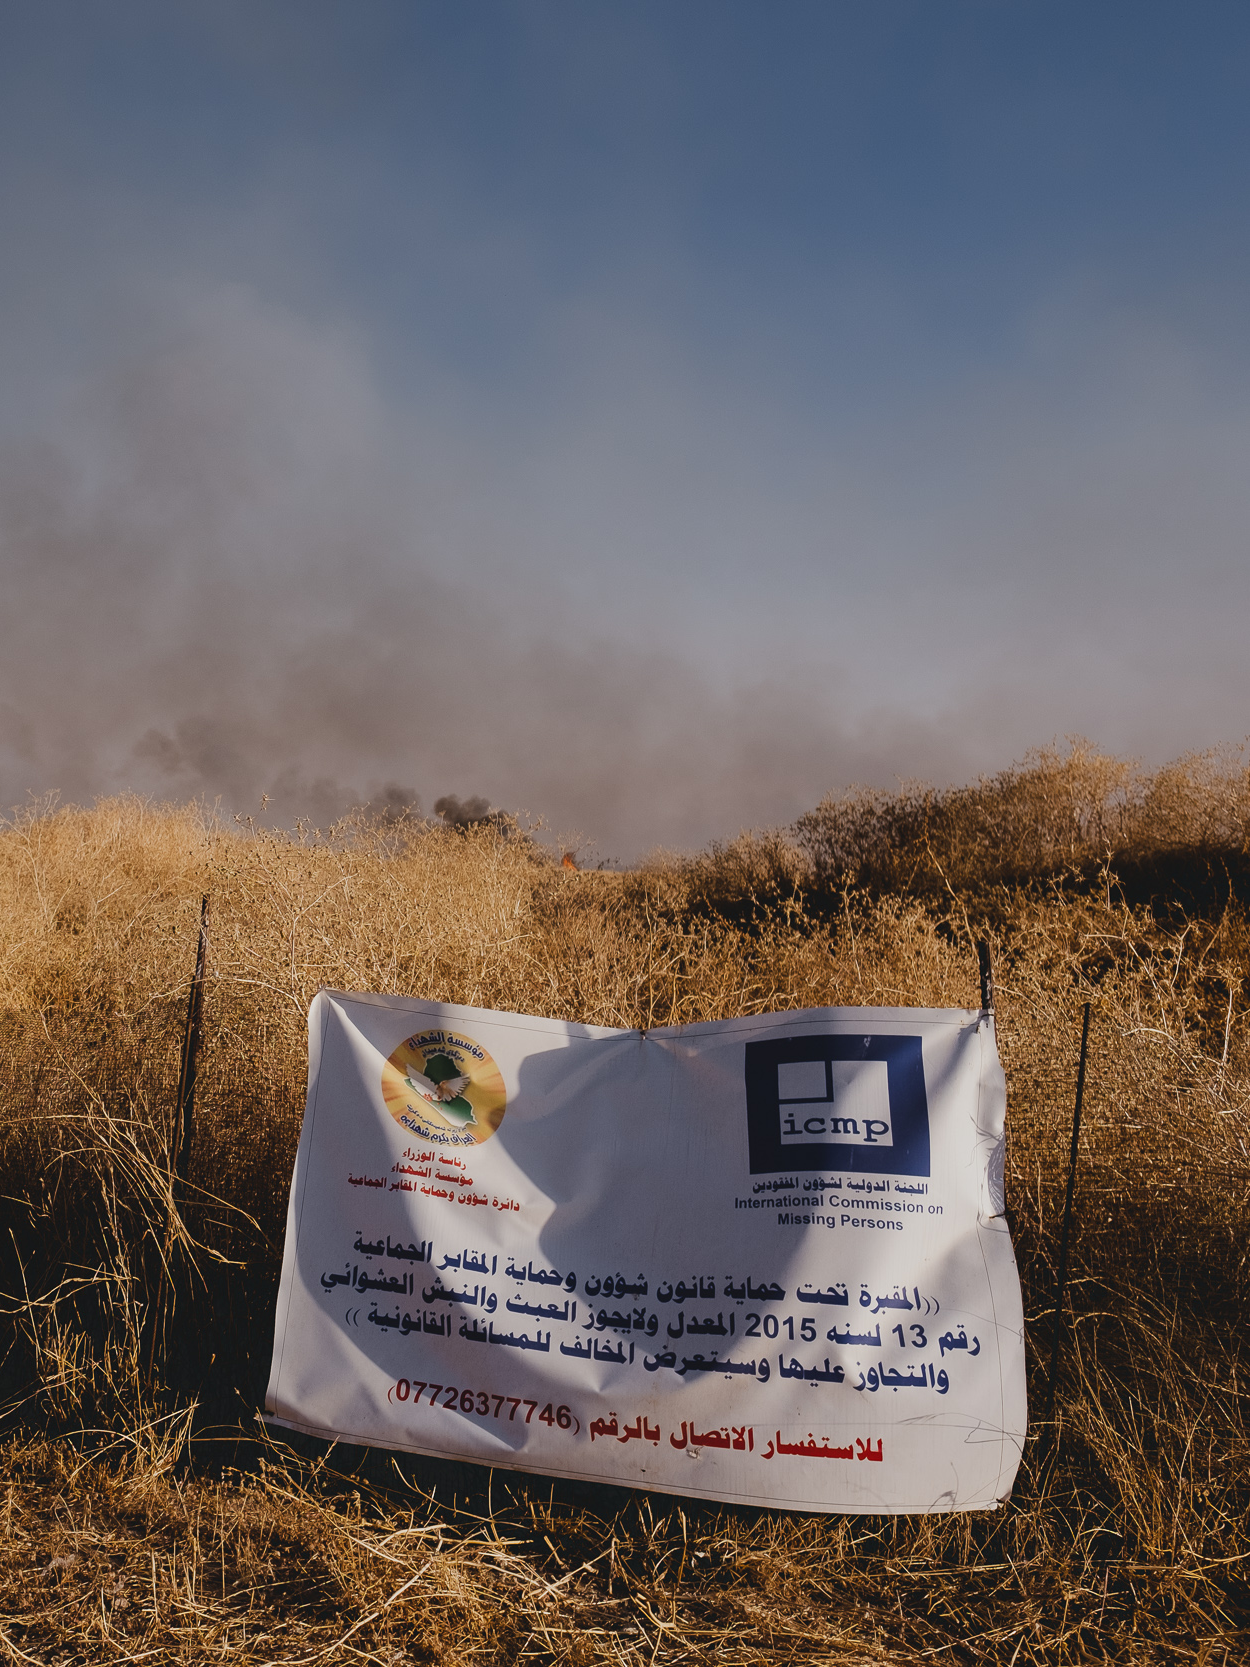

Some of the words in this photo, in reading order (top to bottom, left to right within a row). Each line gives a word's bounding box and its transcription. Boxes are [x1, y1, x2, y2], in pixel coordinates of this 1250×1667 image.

[409, 1032, 445, 1049] الشهداء
[447, 1033, 484, 1058] مؤسسة
[451, 1133, 476, 1144] العراق
[783, 1113, 889, 1142] icmp
[402, 1148, 435, 1163] الوزراء
[348, 1173, 387, 1188] الجماعية
[391, 1162, 432, 1178] الشهداء
[435, 1169, 473, 1187] مؤسسة
[803, 1176, 842, 1191] لشؤون
[389, 1178, 417, 1192] المقابر
[420, 1182, 455, 1201] وحماية
[458, 1193, 488, 1205] شؤون
[752, 1177, 799, 1194] المفقودين
[847, 1177, 889, 1193] الدولية
[894, 1180, 928, 1196] اللجنة
[492, 1196, 520, 1211] دائرة
[735, 1195, 824, 1209] International
[829, 1195, 924, 1213] Commission
[928, 1204, 943, 1214] on
[778, 1213, 835, 1228] Missing
[841, 1215, 903, 1230] Persons
[353, 1231, 433, 1265] الجماعية
[436, 1248, 498, 1276] المقابر
[320, 1263, 414, 1296] العشوائي
[504, 1256, 577, 1293] وحماية
[584, 1271, 648, 1299] شؤون
[422, 1277, 499, 1313] والنبش
[657, 1275, 715, 1303] قانون
[724, 1275, 786, 1306] حماية
[796, 1282, 849, 1306] تحت
[367, 1302, 452, 1337] القانونية
[506, 1293, 577, 1323] العبث
[581, 1307, 658, 1337] ولايجوز
[459, 1316, 552, 1353] للمسائلة
[667, 1311, 735, 1339] المعدل
[745, 1313, 816, 1342] 2015
[892, 1324, 927, 1348] 13
[559, 1335, 635, 1366] المخالف
[938, 1324, 981, 1357] رقم
[643, 1344, 772, 1383] وسيتعرض
[779, 1354, 846, 1388] عليها
[853, 1363, 950, 1395] والتجاوز
[589, 1412, 661, 1445] بالرقم
[670, 1420, 754, 1453] الاتصال
[761, 1430, 883, 1463] للاستفسار
